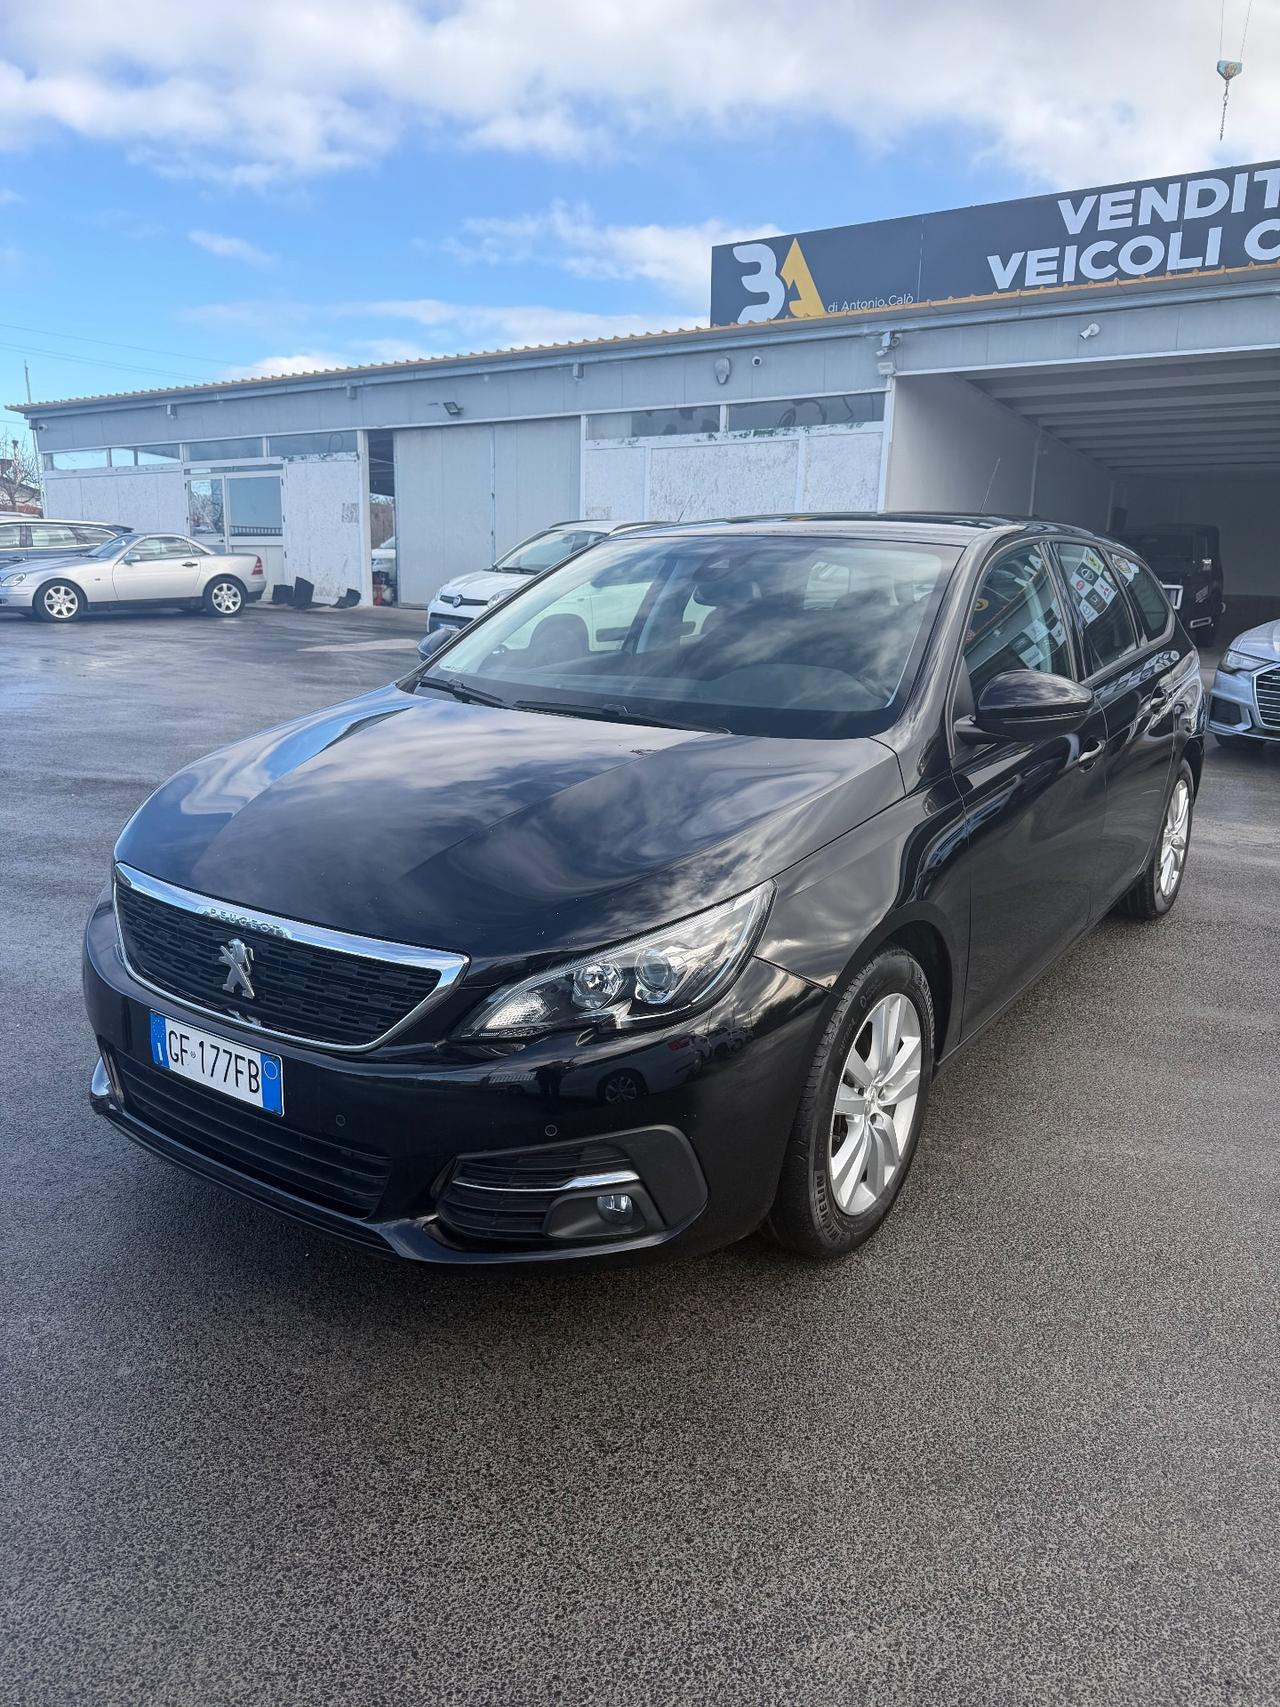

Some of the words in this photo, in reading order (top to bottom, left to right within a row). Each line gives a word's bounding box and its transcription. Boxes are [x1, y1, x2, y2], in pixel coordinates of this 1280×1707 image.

[1057, 168, 1280, 235] VENDIT
[987, 227, 1223, 290] VEICOLI
[827, 301, 838, 313] di
[841, 297, 886, 312] Antonio
[888, 293, 914, 305] Calò
[209, 907, 282, 936] PEUGEOT
[168, 1029, 191, 1066] GF
[198, 1040, 261, 1094] 177FB
[815, 1174, 841, 1241] MICHELIN
